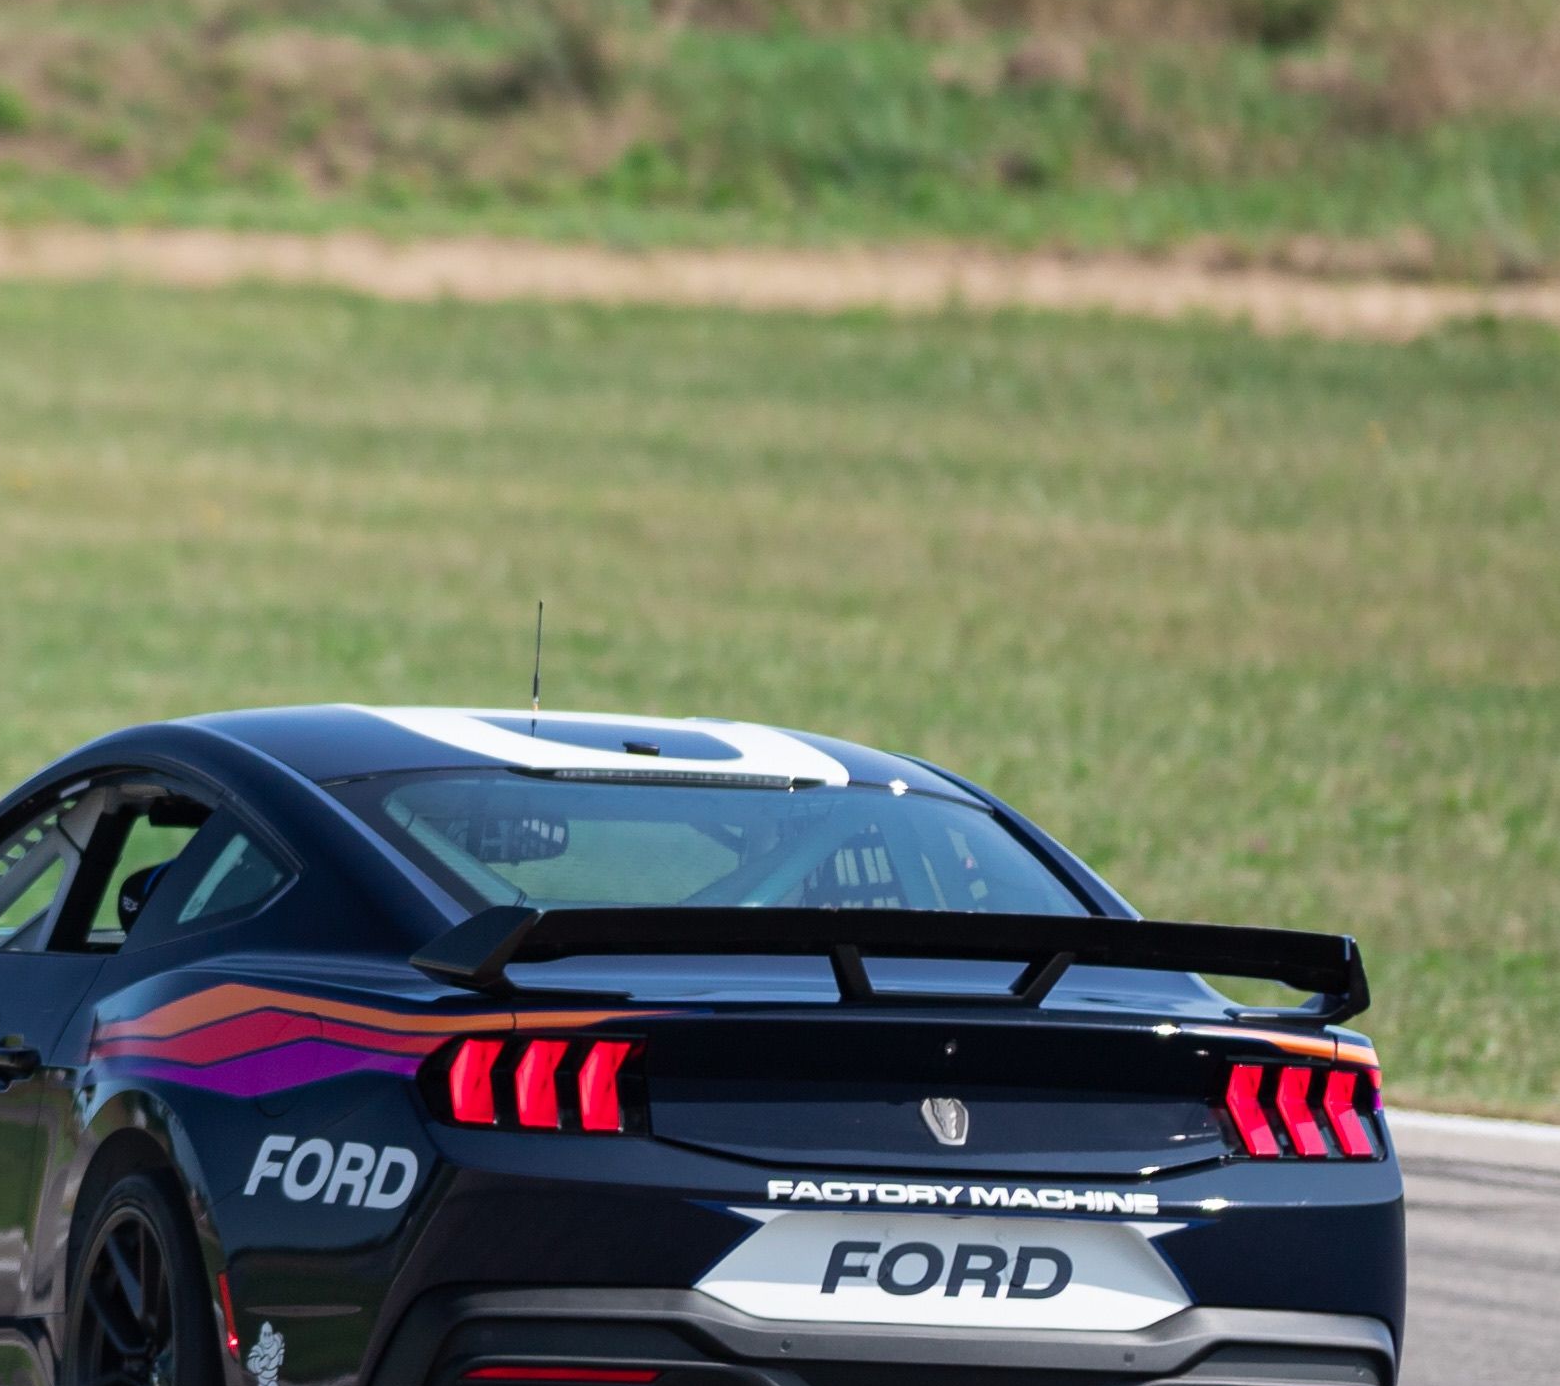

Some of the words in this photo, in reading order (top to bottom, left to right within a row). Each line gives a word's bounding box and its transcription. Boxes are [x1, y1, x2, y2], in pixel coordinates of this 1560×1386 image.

[243, 1134, 419, 1210] FORD
[767, 1179, 966, 1206] FACTORY
[970, 1185, 1159, 1215] MACHINE
[820, 1240, 1074, 1300] FORD
